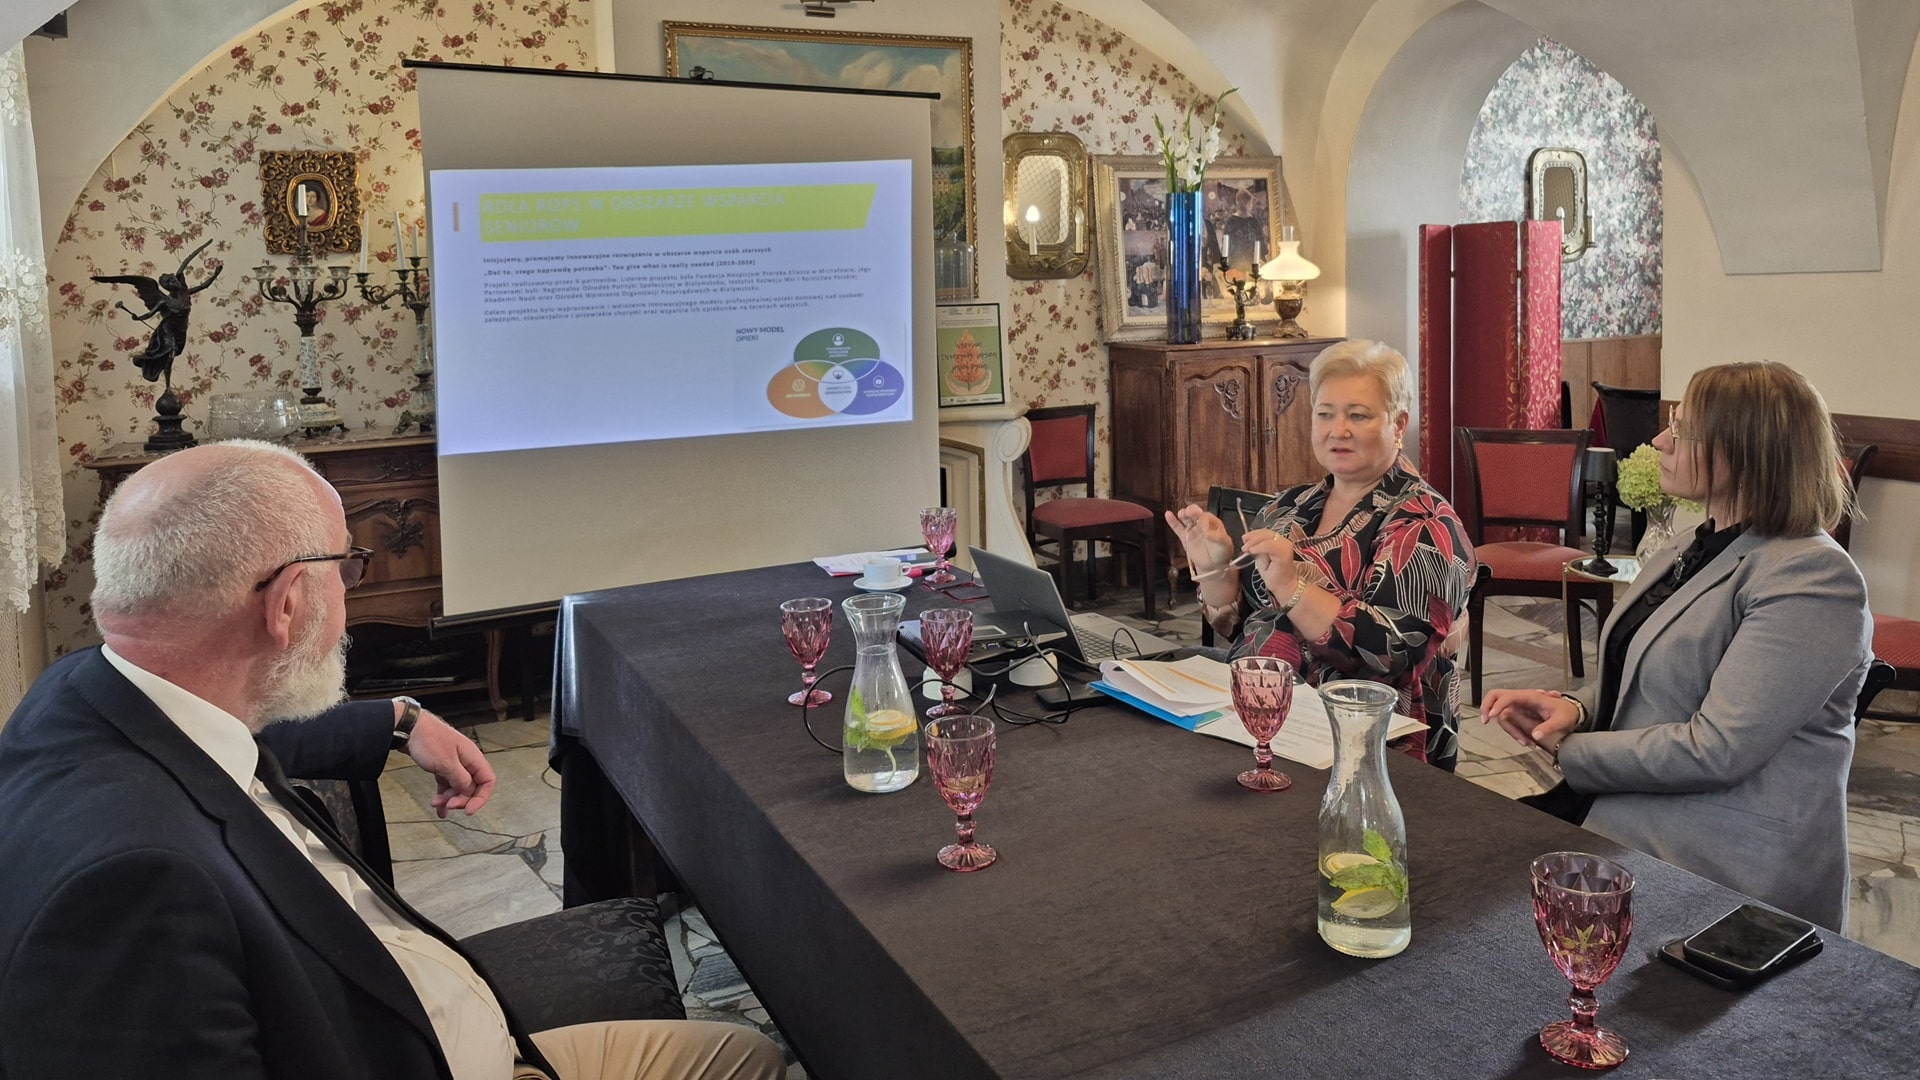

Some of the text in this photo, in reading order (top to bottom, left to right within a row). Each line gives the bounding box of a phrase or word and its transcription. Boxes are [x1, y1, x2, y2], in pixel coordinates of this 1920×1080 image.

[484, 192, 785, 214] ROLA ROPS W OBSZARZE WSPARCIA
[484, 217, 581, 234] SENIORÓW
[483, 256, 523, 265] Inicjujemy,
[736, 327, 758, 335] NOWY
